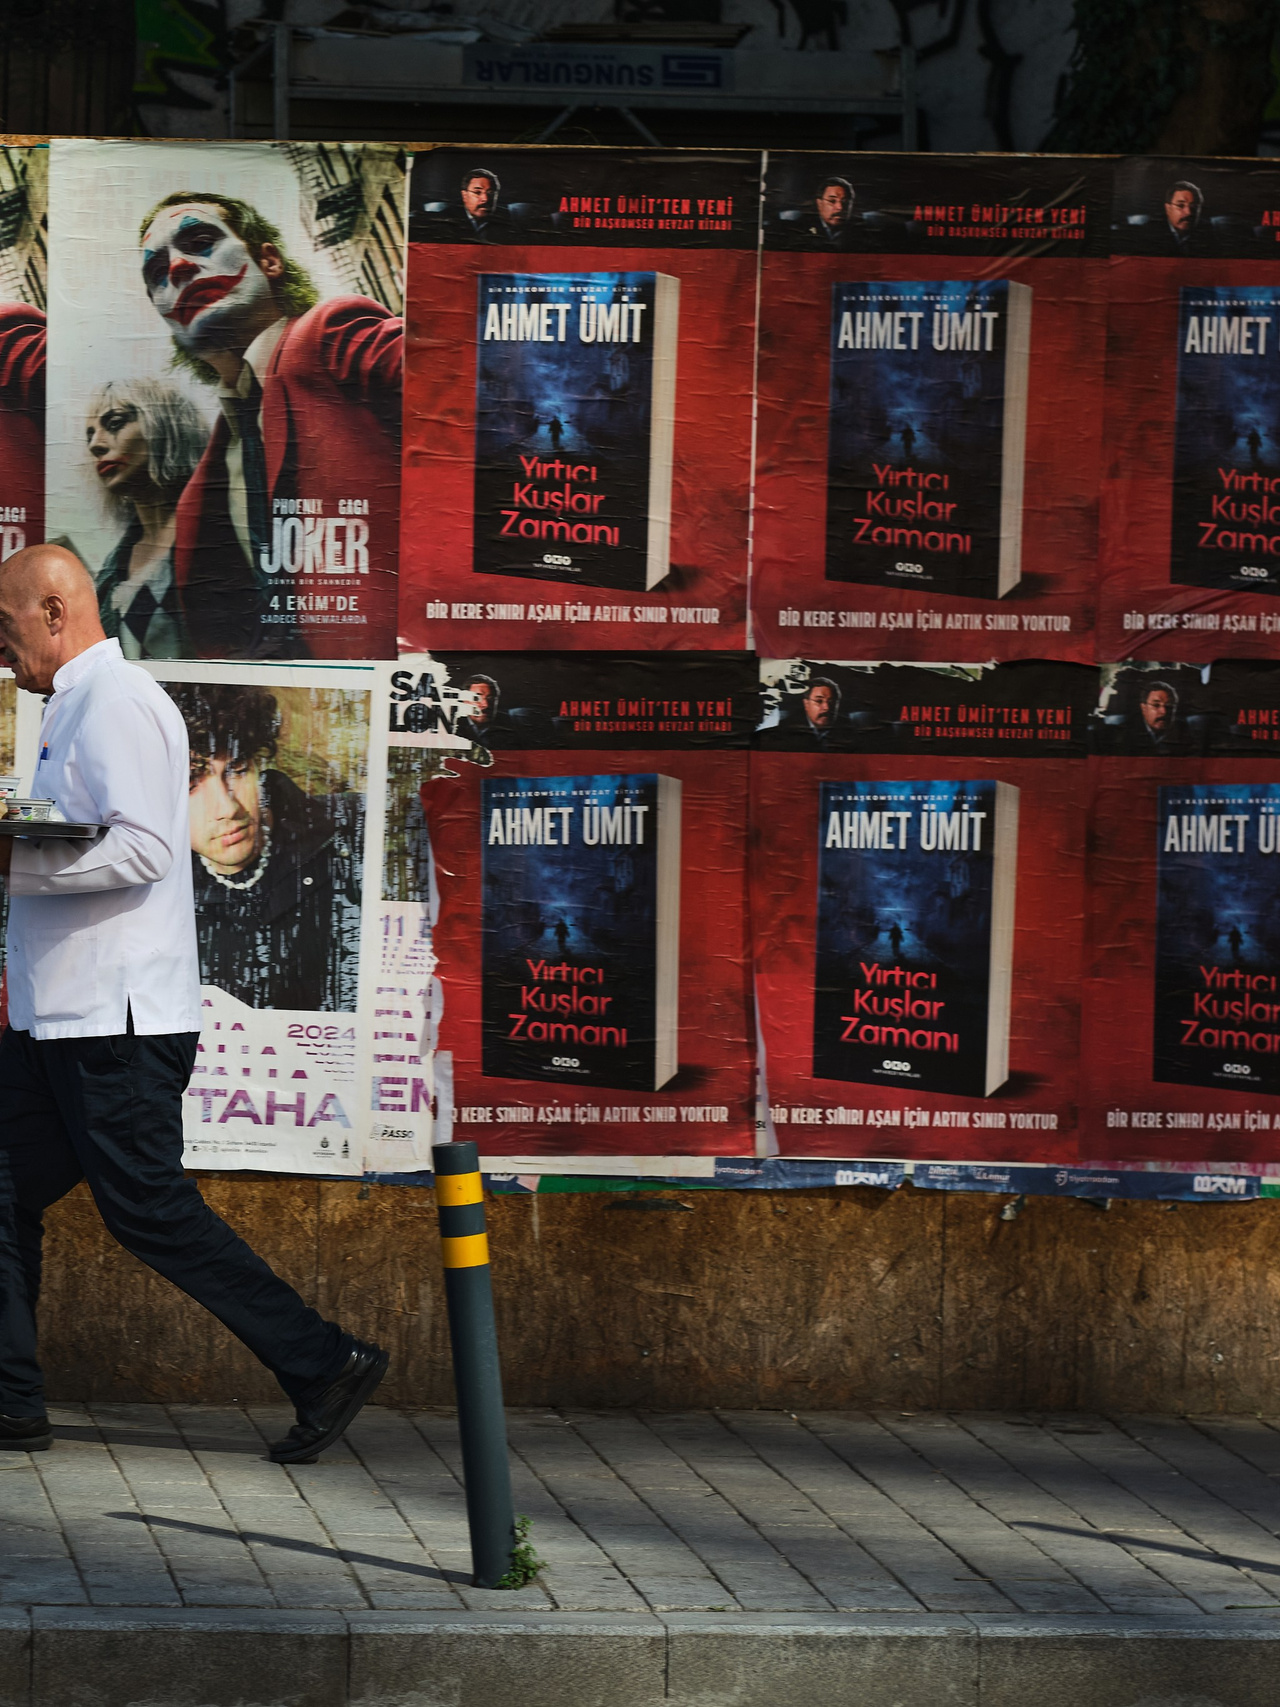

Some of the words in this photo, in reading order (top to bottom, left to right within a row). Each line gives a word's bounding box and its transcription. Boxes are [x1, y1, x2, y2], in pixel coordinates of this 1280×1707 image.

[476, 60, 654, 86] SUNGURLAR
[560, 197, 610, 213] AHMET
[698, 197, 733, 215] YENİ
[913, 206, 965, 222] AHMET
[1051, 206, 1086, 224] YENİ
[658, 219, 694, 230] NEVZAT
[484, 304, 571, 341] AHMET
[580, 296, 647, 342] ÜMİT
[838, 312, 923, 349] AHMET
[933, 304, 999, 351] ÜMİT
[1185, 316, 1271, 355] AHMET
[519, 455, 597, 483] Yırtıcı
[872, 464, 949, 490] Yırtıcı
[273, 498, 323, 514] PHOENIX
[338, 499, 369, 515] GAGA
[514, 483, 605, 517] Kuşlar
[866, 490, 957, 523] Kuşlar
[500, 511, 619, 546] Zamanı
[852, 518, 971, 554] Zamanı
[260, 517, 369, 574] JOKER
[270, 596, 280, 610] 4
[287, 593, 358, 611] EKİM'DE
[426, 600, 448, 619] BİR
[451, 603, 483, 619] KERE
[486, 604, 524, 620] SINIRI
[527, 605, 561, 622] AŞAN
[565, 602, 590, 623] İÇİN
[594, 606, 631, 621] ARTIK
[634, 607, 666, 622] SINIR
[670, 608, 719, 624] YOKTUR
[260, 615, 297, 623] SADECE
[779, 607, 800, 627] BİR
[803, 611, 835, 627] KERE
[838, 611, 875, 628] SINIRI
[879, 611, 913, 631] AŞAN
[917, 610, 942, 631] İÇİN
[946, 613, 982, 629] ARTIK
[986, 614, 1018, 631] SINIR
[1022, 615, 1070, 632] YOKTUR
[389, 703, 458, 734] LON
[560, 701, 610, 717] AHMET
[697, 698, 732, 716] YENİ
[900, 705, 950, 723] AHMET
[1037, 706, 1071, 725] YENİ
[1238, 709, 1279, 725] AHME
[659, 721, 694, 732] NEVZAT
[489, 807, 574, 845] AHMET
[583, 798, 649, 845] ÜMİT
[825, 812, 911, 849] AHMET
[920, 804, 986, 851] ÜMİT
[1164, 815, 1249, 853] AHMET
[526, 959, 604, 985] Yırtıcı
[859, 962, 937, 990] Yırtıcı
[1200, 966, 1276, 992] Yırtıcı
[521, 986, 612, 1018] Kuşlar
[854, 989, 945, 1023] Kuşlar
[288, 1024, 355, 1040] 2024
[508, 1014, 628, 1048] Zamanı
[840, 1016, 959, 1053] Zamanı
[188, 1088, 352, 1128] TAHA
[462, 1107, 493, 1123] KERE
[496, 1107, 534, 1123] SINIRI
[537, 1107, 571, 1125] AŞAN
[574, 1103, 600, 1125] İÇİN
[604, 1107, 640, 1122] ARTIK
[643, 1107, 676, 1123] SINIR
[680, 1107, 728, 1123] YOKTUR
[791, 1108, 823, 1124] KERE
[826, 1107, 863, 1125] SINIRI
[866, 1109, 901, 1129] AŞAN
[904, 1107, 930, 1129] İÇİN
[932, 1111, 970, 1128] ARTIK
[973, 1113, 1006, 1129] SINIR
[1009, 1113, 1058, 1130] YOKTUR
[1107, 1109, 1128, 1128] BİR
[1132, 1112, 1162, 1128] KERE
[1166, 1113, 1203, 1129] SINIRI
[1207, 1113, 1241, 1131] AŞAN
[1245, 1111, 1270, 1132] İÇİN
[381, 1129, 414, 1138] PASSO
